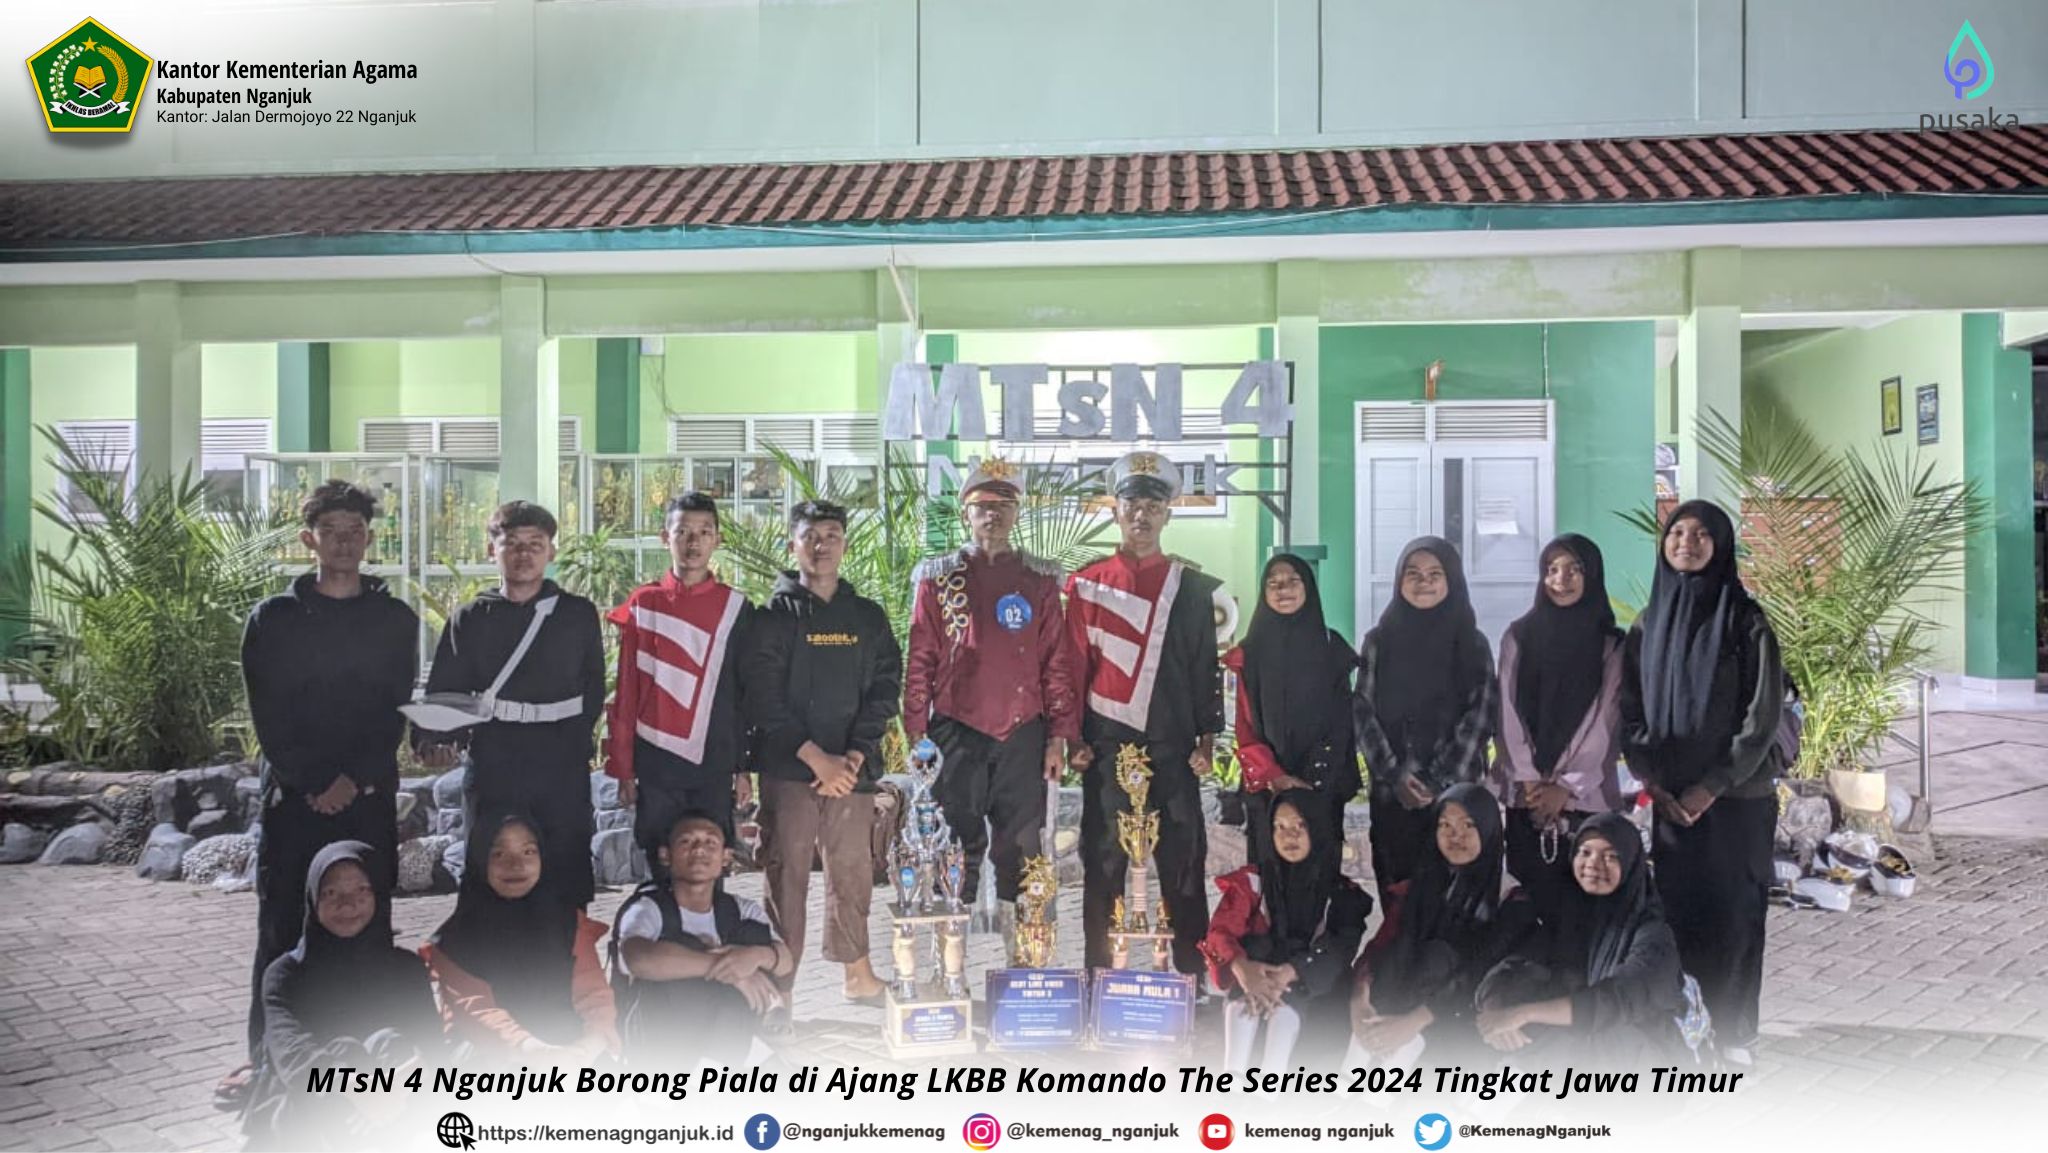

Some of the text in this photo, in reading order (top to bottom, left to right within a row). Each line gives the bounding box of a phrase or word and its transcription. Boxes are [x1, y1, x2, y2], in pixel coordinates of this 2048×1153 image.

[882, 360, 1295, 441] MTsN 4
[1005, 608, 1024, 623] 02
